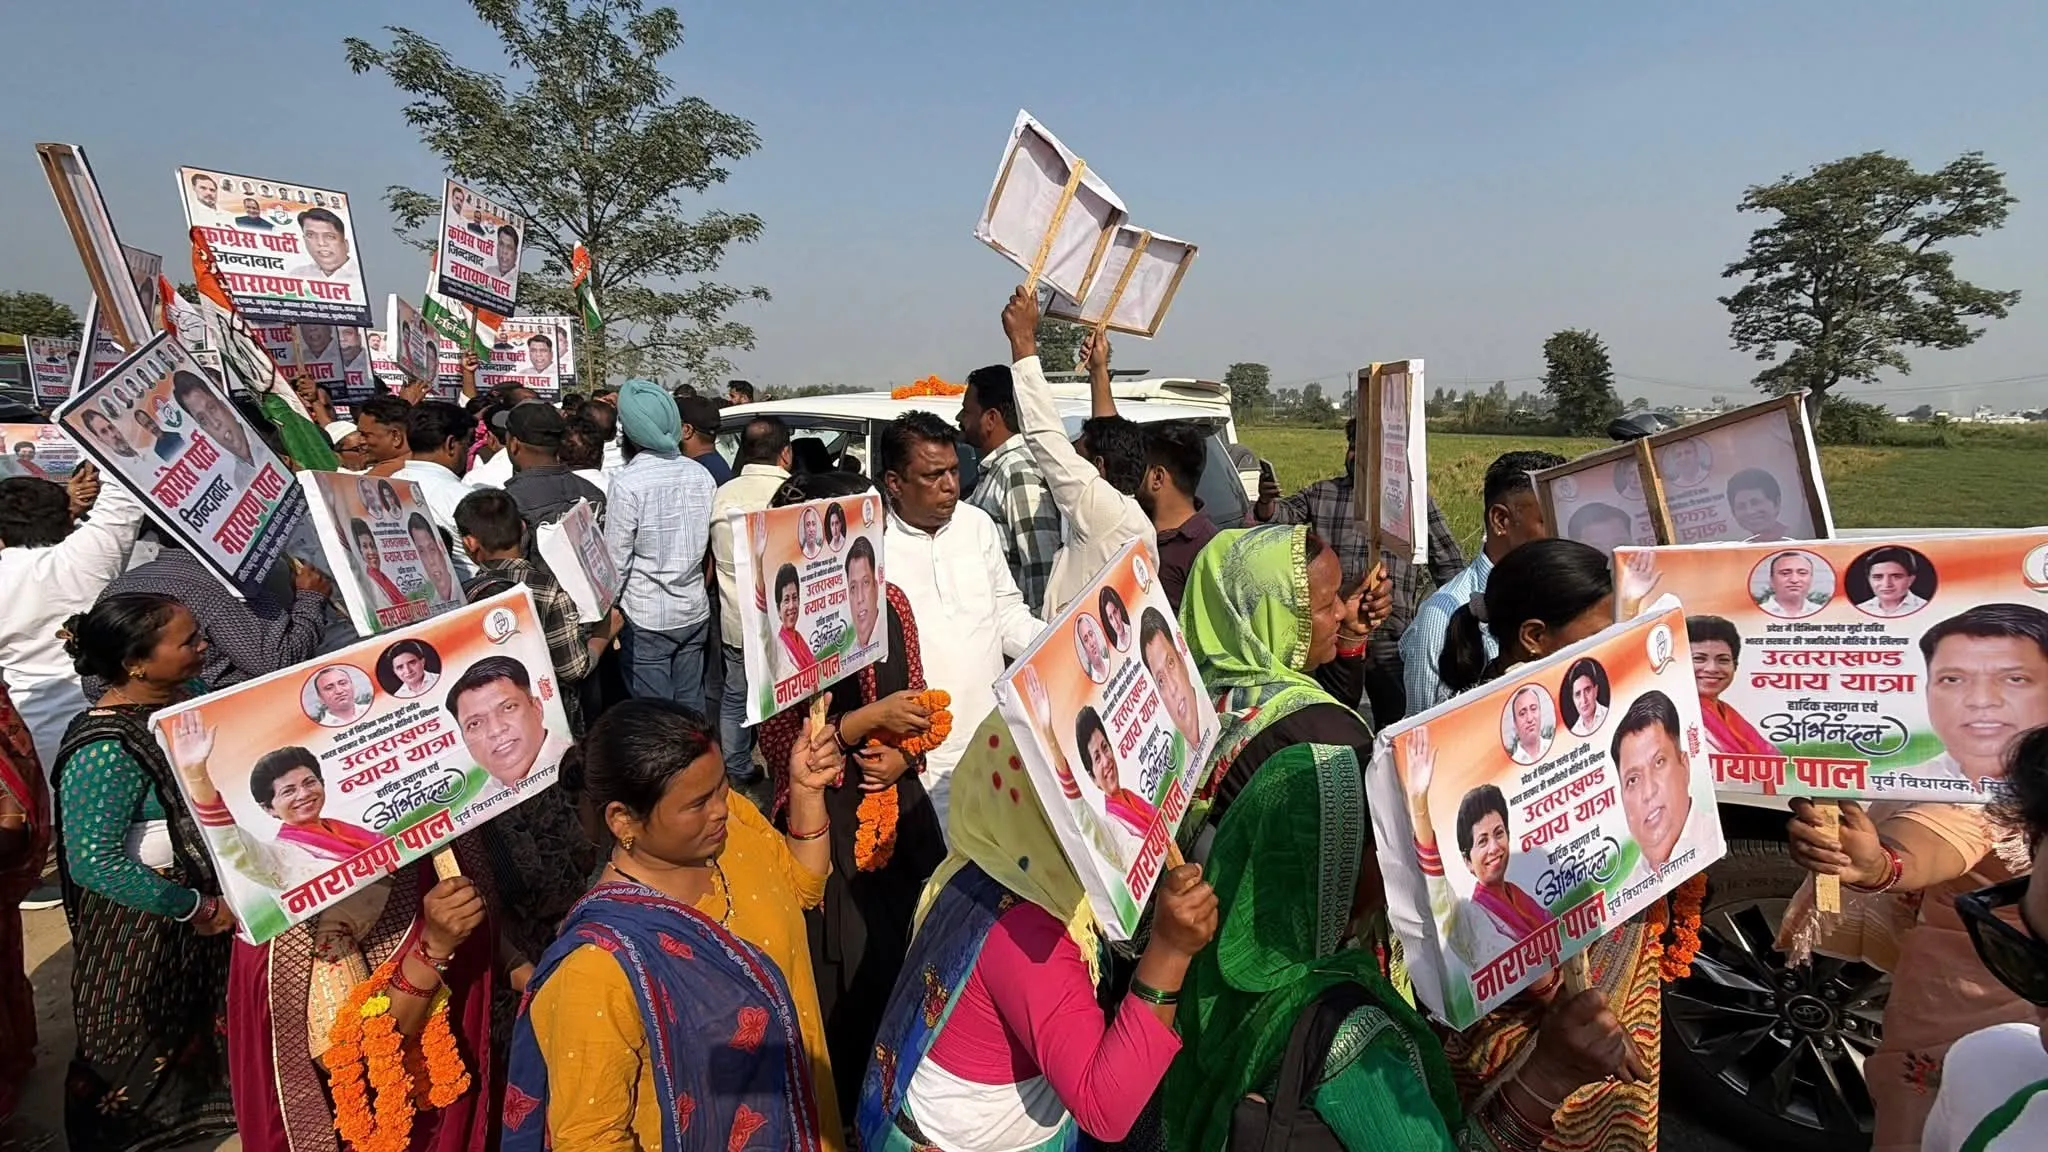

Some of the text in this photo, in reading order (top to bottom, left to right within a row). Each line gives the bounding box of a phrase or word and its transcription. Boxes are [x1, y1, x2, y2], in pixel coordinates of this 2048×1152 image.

[260, 232, 300, 254] पार्टी
[448, 225, 495, 256] कांग्रेस पार्टी
[308, 280, 351, 300] पाल
[450, 260, 489, 288] नारायण
[491, 277, 511, 297] पाल
[527, 376, 551, 387] पाल
[151, 429, 220, 509] कांग्रेस पार्टी
[179, 474, 233, 533] जिन्दाबाद
[213, 489, 268, 555] नारायण
[251, 462, 287, 501] पाल
[804, 588, 847, 615] न्याय यात्रा
[774, 662, 819, 703] नारायण
[819, 653, 841, 679] पाल
[1750, 672, 1917, 693] न्याय यात्रा
[1762, 650, 1904, 667] उत्तराखण्ड
[1111, 673, 1148, 733] उत्तराखण्ड
[1118, 716, 1142, 759] न्याय
[1139, 688, 1160, 723] यात्रा
[1786, 698, 1878, 713] हार्दिक स्वागत एवं
[338, 717, 441, 770] उत्तराखण्ड
[1760, 713, 1908, 756] अभिनंदन
[337, 730, 456, 793] न्याय यात्रा
[375, 761, 440, 798] हार्दिक स्वागत एवं
[1792, 757, 1868, 791] पाल
[1871, 775, 1895, 793] पूर्व
[362, 768, 466, 830] अभिनंदन
[1519, 786, 1616, 853] न्याय यात्रा
[1523, 765, 1605, 823] उत्तराखण्ड
[280, 836, 402, 915] नारायण
[399, 808, 456, 851] पाल
[454, 807, 471, 826] पूर्व
[1126, 809, 1171, 901] नारायण
[1160, 776, 1187, 825] पाल
[1547, 824, 1600, 865] हार्दिक स्वागत एवं
[1535, 836, 1620, 906] अभिनंदन
[1471, 918, 1561, 1002] नारायण
[1559, 889, 1606, 944] पाल
[1607, 890, 1621, 915] पूर्व
[1660, 848, 1696, 882] सितारगंज
